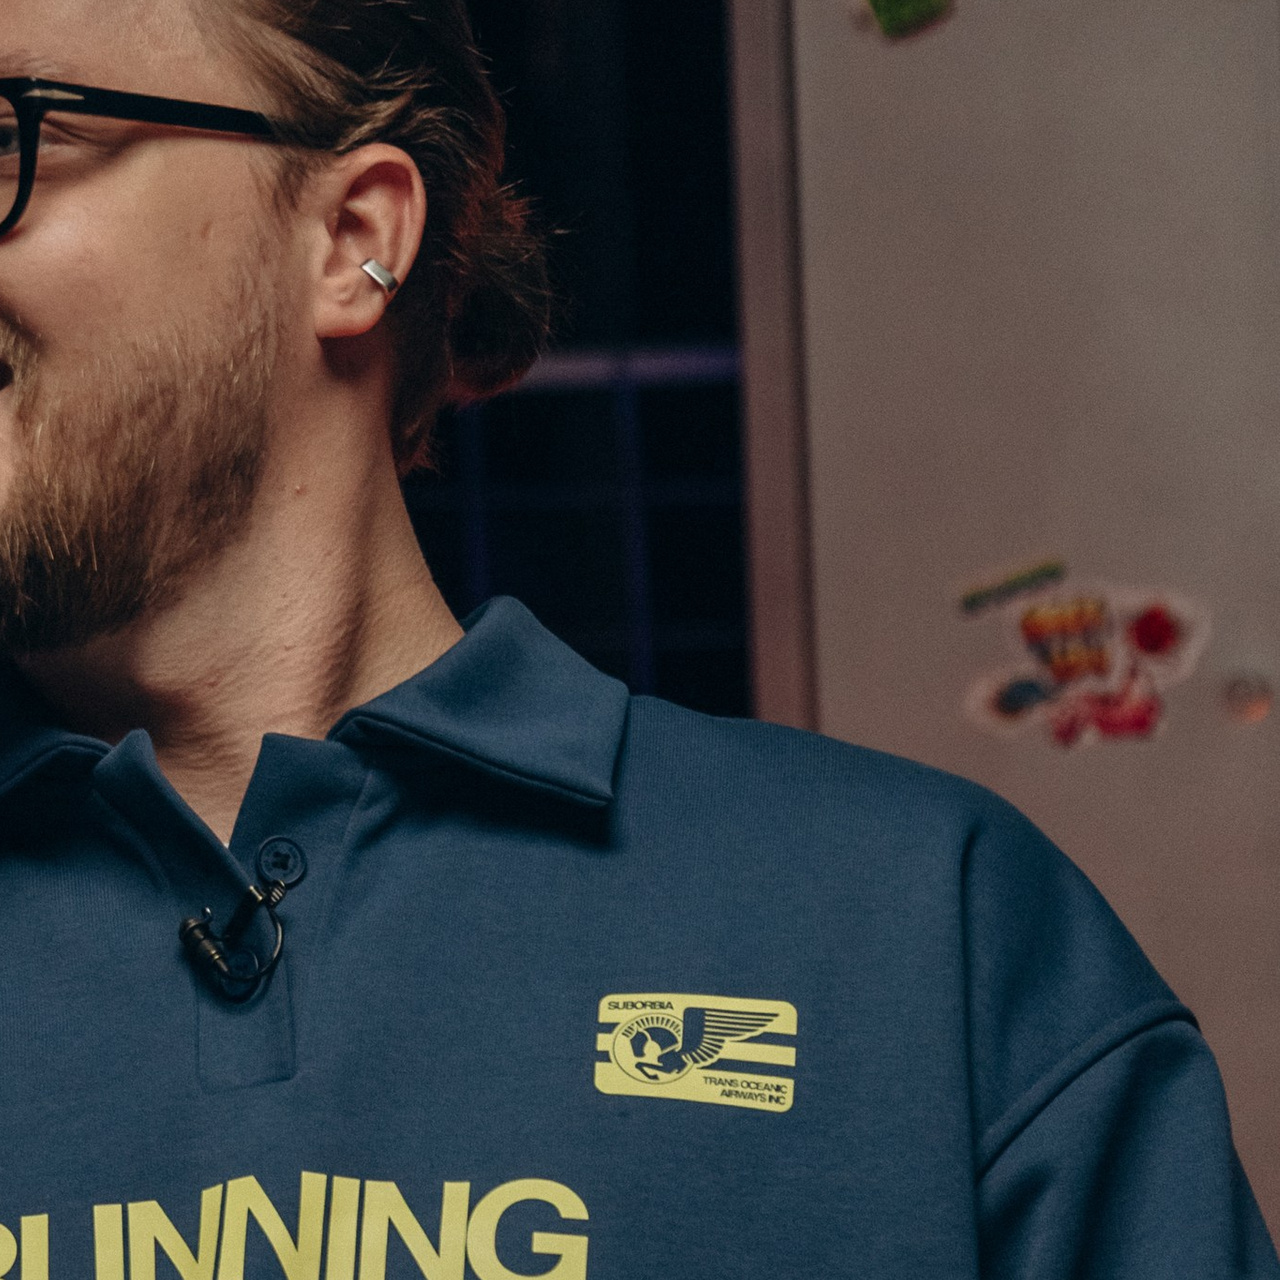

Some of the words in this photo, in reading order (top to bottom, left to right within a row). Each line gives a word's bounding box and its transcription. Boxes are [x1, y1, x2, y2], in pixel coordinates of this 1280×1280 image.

[607, 1000, 674, 1011] SUBORBIA
[703, 1076, 739, 1087] TRANS
[740, 1080, 788, 1094] OCEANIC
[720, 1089, 767, 1103] AIRWAYS
[768, 1094, 786, 1106] INC
